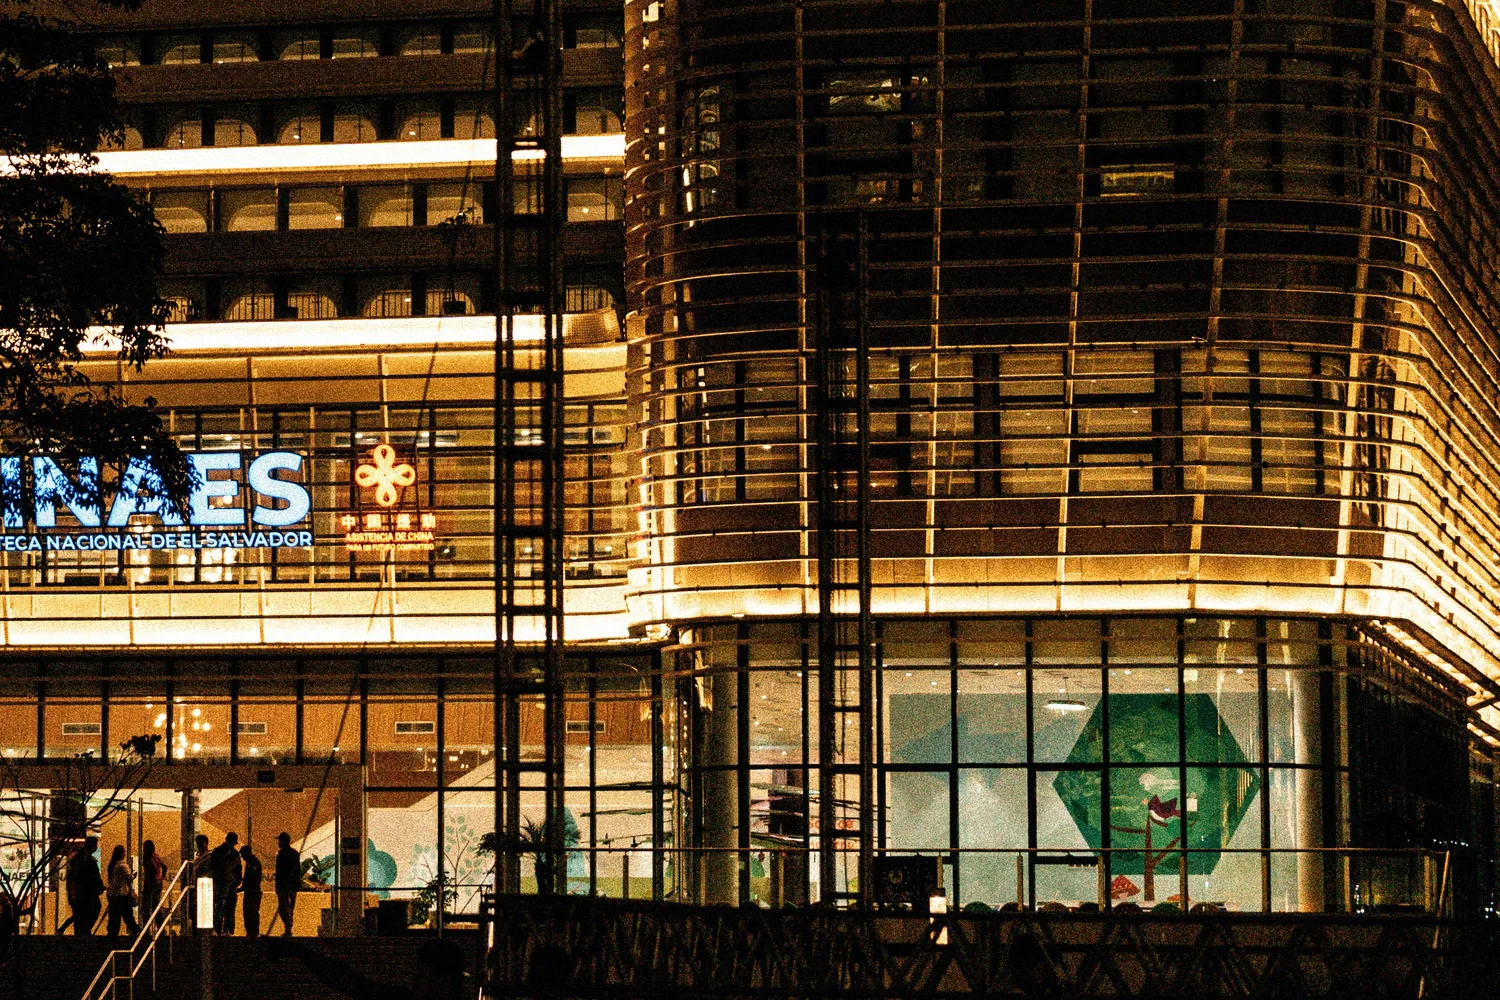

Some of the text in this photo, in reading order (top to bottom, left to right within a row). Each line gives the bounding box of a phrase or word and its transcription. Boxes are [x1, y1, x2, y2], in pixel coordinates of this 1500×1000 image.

[46, 534, 148, 551] NACIONAL
[151, 533, 177, 549] DE
[180, 532, 202, 549] EL
[205, 531, 313, 548] SALVADOR
[345, 531, 434, 542] ASISTENCIA DE CHINA
